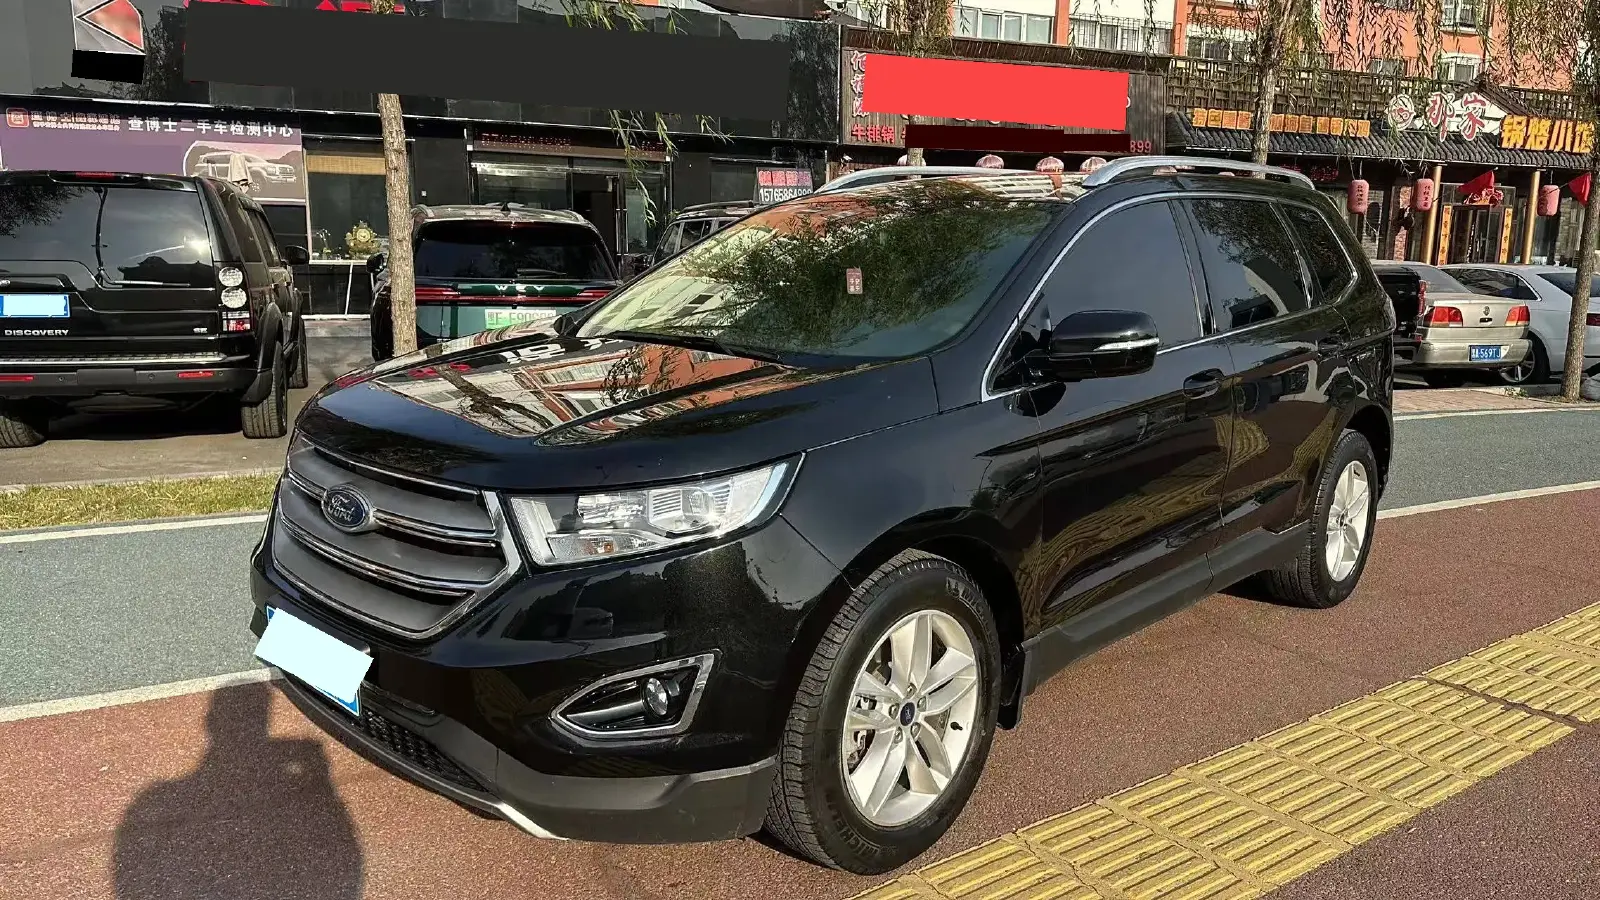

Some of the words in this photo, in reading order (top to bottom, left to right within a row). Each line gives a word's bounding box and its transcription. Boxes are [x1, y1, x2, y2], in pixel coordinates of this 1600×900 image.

[127, 115, 294, 138] 查博士二手车检测中心
[851, 123, 895, 143] 牛排锅
